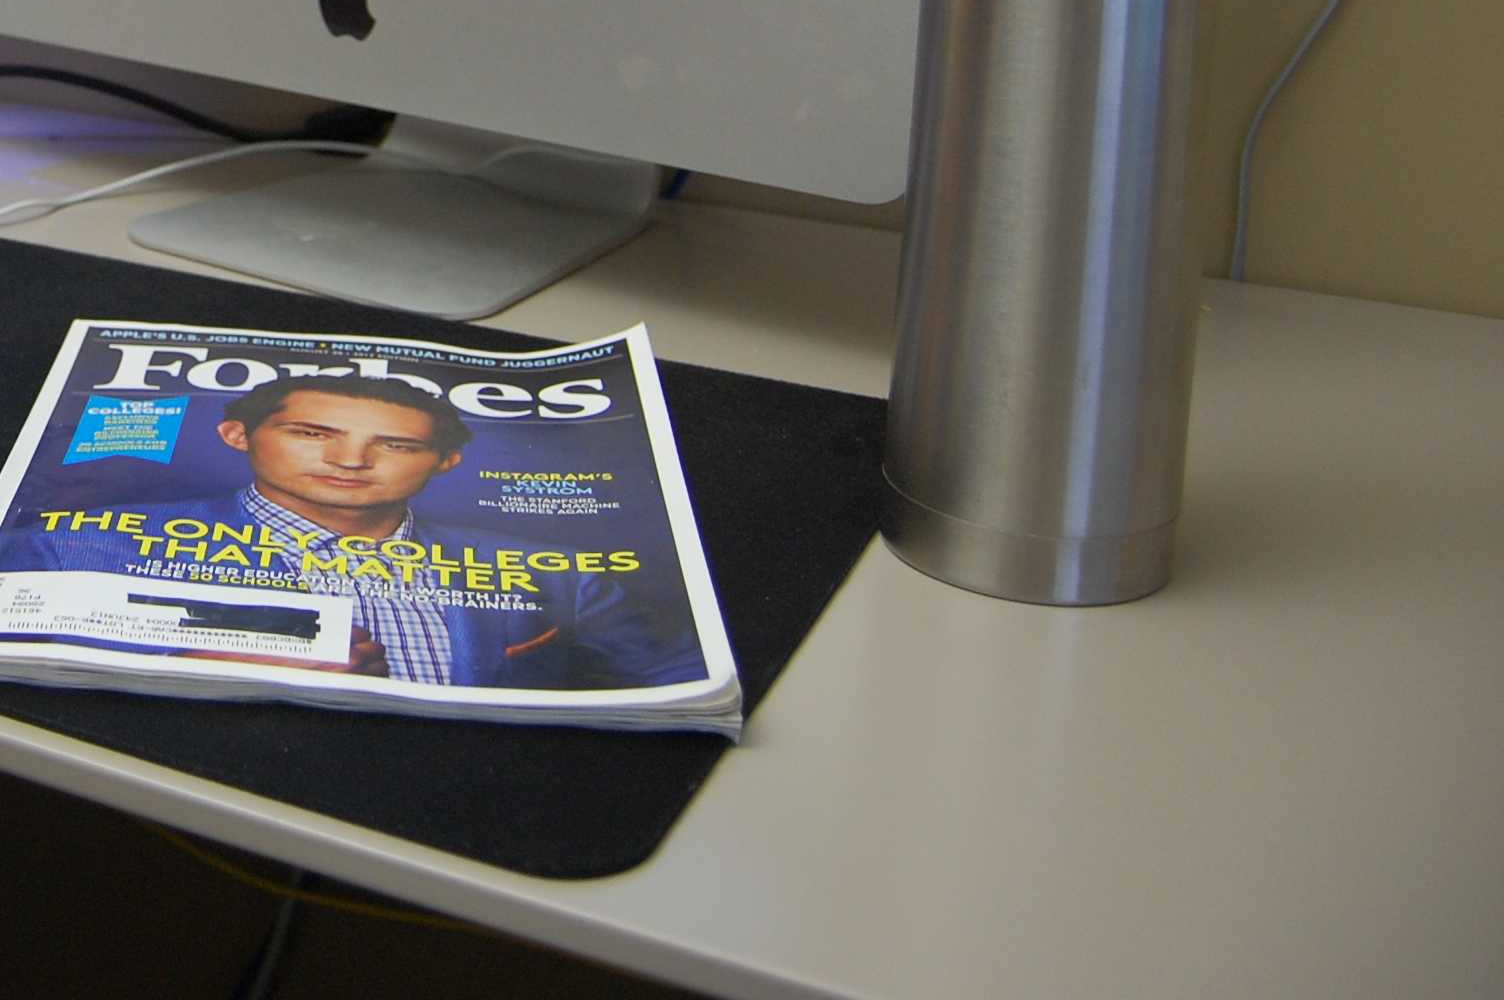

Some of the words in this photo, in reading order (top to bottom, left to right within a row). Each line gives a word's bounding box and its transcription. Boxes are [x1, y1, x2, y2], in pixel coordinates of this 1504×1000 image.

[99, 329, 168, 340] APPLE'S
[171, 332, 201, 342] U.S.
[206, 335, 249, 344] JOBS
[252, 337, 316, 349] ENGINE
[331, 342, 373, 352] NEW
[375, 345, 445, 360] MUTUAL
[448, 353, 496, 367] FUND
[499, 345, 615, 368] JUGGERNAUT
[87, 406, 182, 415] COLLEGES!
[120, 400, 155, 410] TOP
[479, 470, 613, 481] INSTAGRAM'S
[516, 479, 577, 488] KEVIN
[501, 485, 593, 495] SYSTROM
[479, 499, 558, 510] BILLIONAIRE
[562, 501, 620, 509] MACHINE
[528, 496, 596, 504] STANFORD
[501, 506, 554, 515] STRIKES
[40, 511, 147, 534] THE
[163, 519, 319, 549] ONLY
[338, 535, 640, 573] COLLEGES
[132, 535, 284, 568] THAT
[302, 552, 540, 593] MATTER
[146, 559, 163, 571] IS
[167, 561, 239, 577] HIGHER
[244, 569, 354, 587] EDUCATION
[364, 578, 417, 593] STILL
[418, 587, 491, 601] WORTH
[495, 592, 523, 602] IT?
[125, 564, 184, 580] THESE
[189, 571, 213, 582] 50
[217, 575, 309, 590] SCHOOLS
[310, 581, 353, 597] ARE
[359, 588, 399, 600] THE
[401, 590, 543, 611] NO-BRAINERS.
